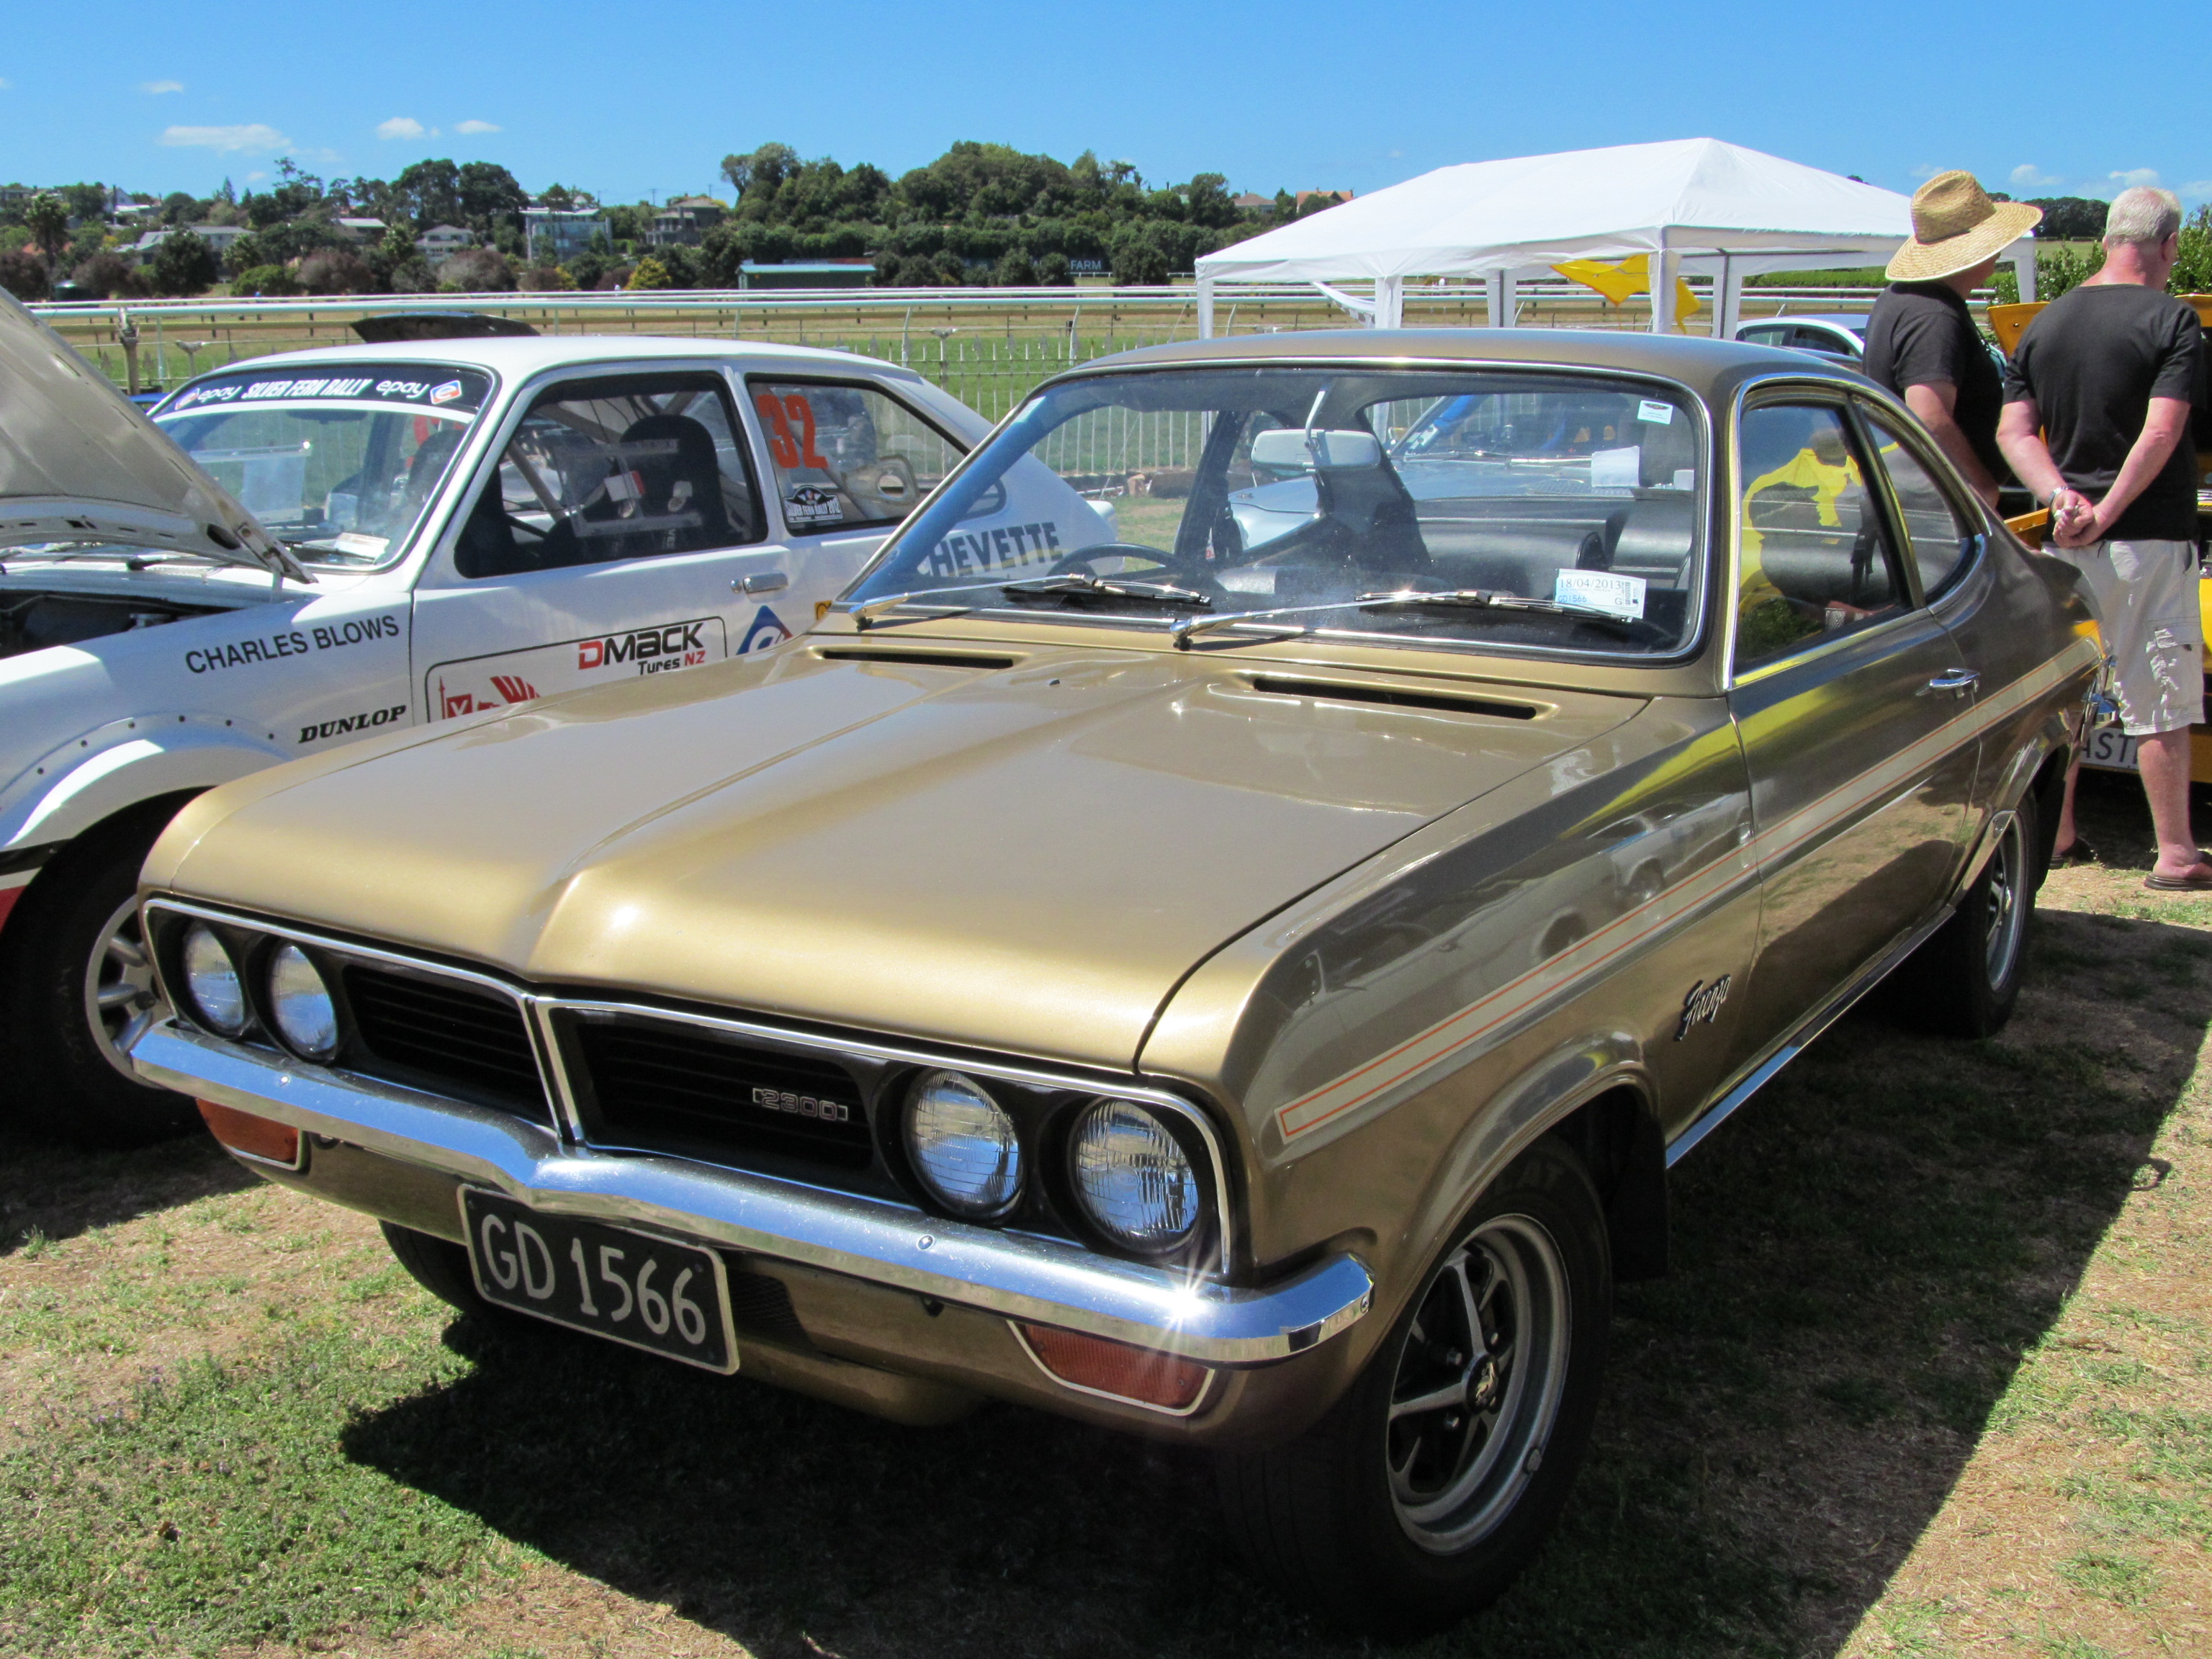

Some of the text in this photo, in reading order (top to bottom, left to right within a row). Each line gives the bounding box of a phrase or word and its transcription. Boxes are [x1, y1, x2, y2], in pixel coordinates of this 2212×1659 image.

[1070, 259, 1102, 271] FARM
[197, 385, 243, 403] epay
[241, 379, 374, 400] SILVER FERN RALLY
[375, 379, 431, 399] epay
[757, 393, 830, 469] 32
[924, 521, 1064, 577] HEVETTE
[1560, 578, 1622, 590] 18/04/2013
[185, 616, 400, 673] CHARLES BLOWS
[684, 650, 706, 667] NZ
[297, 705, 407, 743] DUNLOP
[761, 1088, 837, 1122] 2300
[481, 1213, 706, 1346] GD 1566
